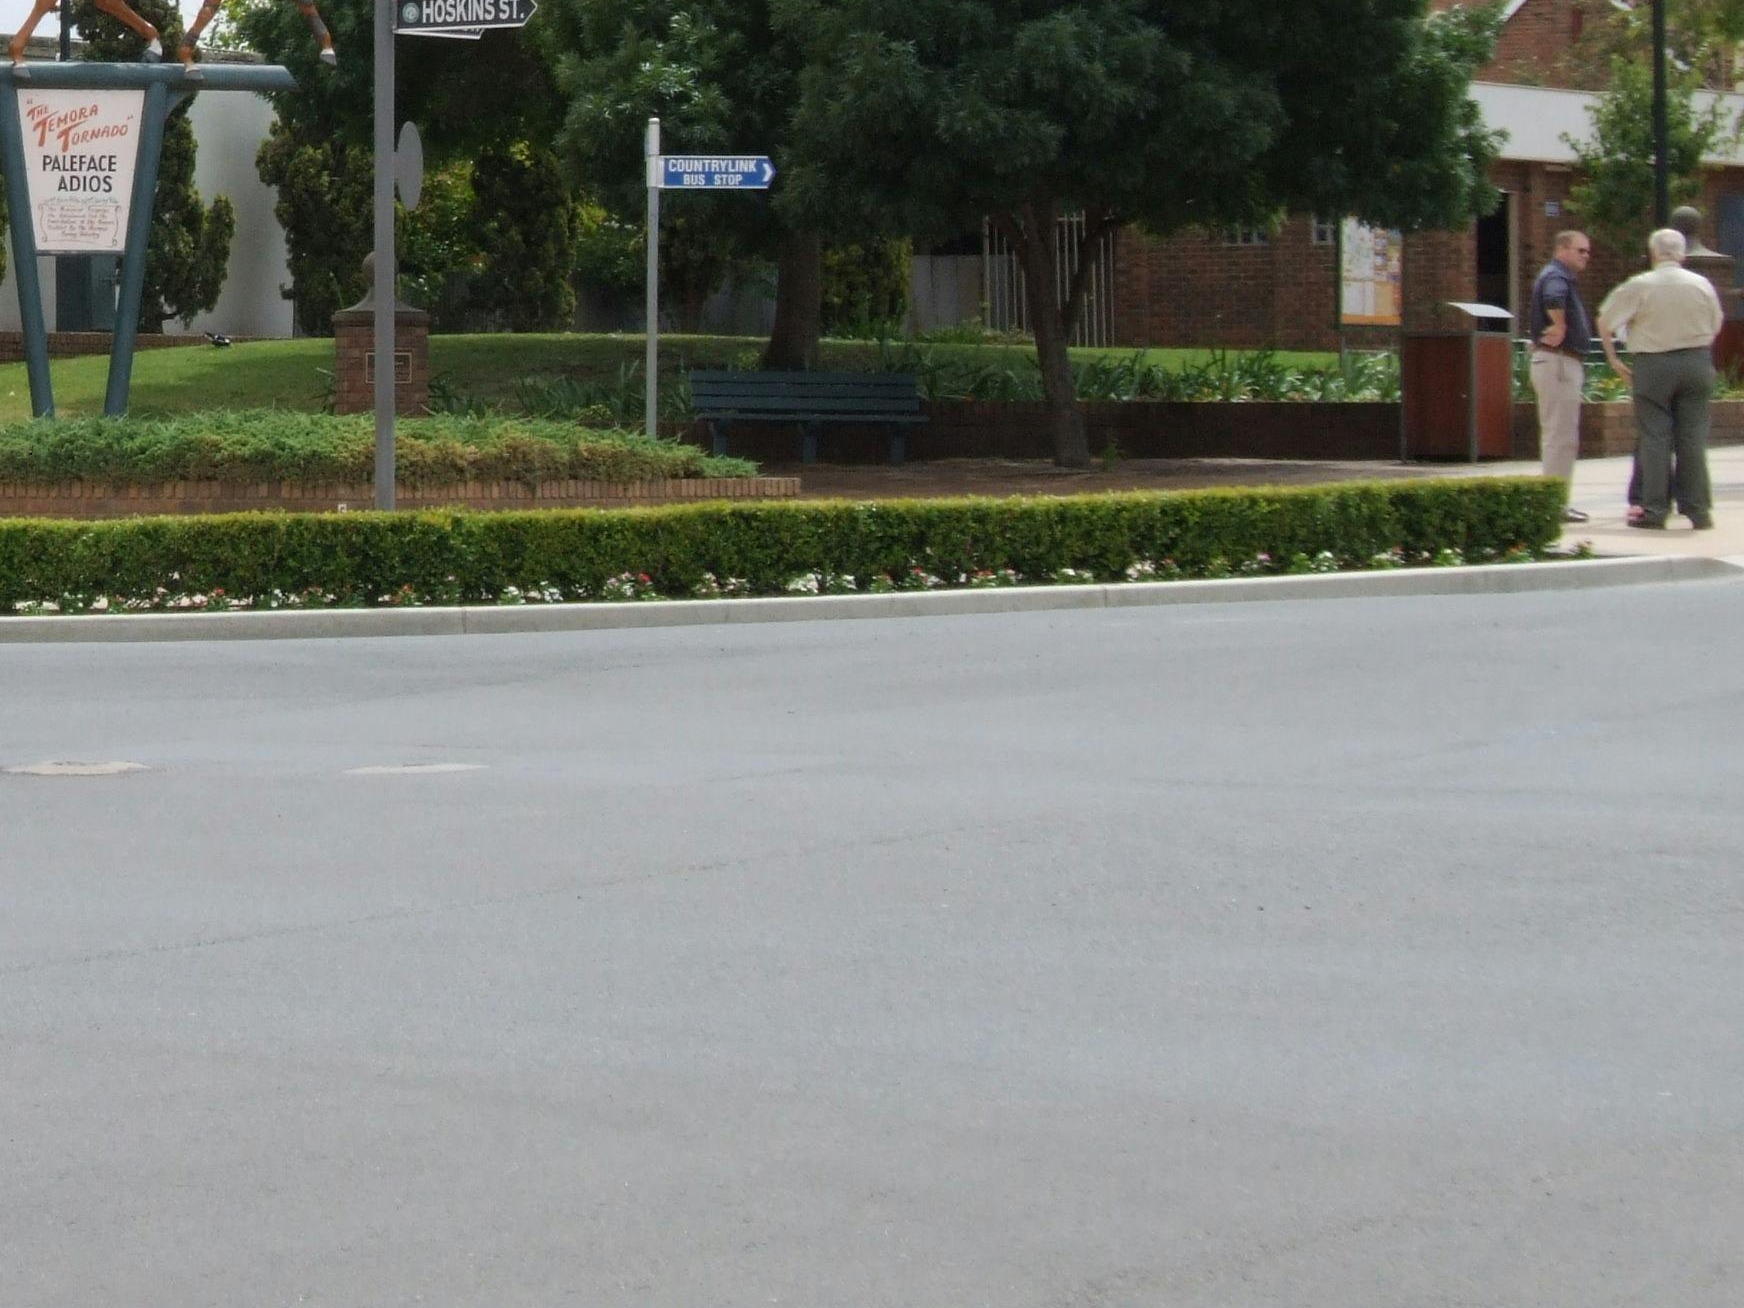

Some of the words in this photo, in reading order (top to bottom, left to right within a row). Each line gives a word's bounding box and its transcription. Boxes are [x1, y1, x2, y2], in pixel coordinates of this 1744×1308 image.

[33, 103, 99, 148] TEMORA
[42, 155, 117, 172] PALEFACE
[668, 159, 757, 172] COUNTRYLINK
[57, 175, 113, 193] ADIOS
[683, 174, 706, 185] BUS
[714, 174, 743, 185] STOP
